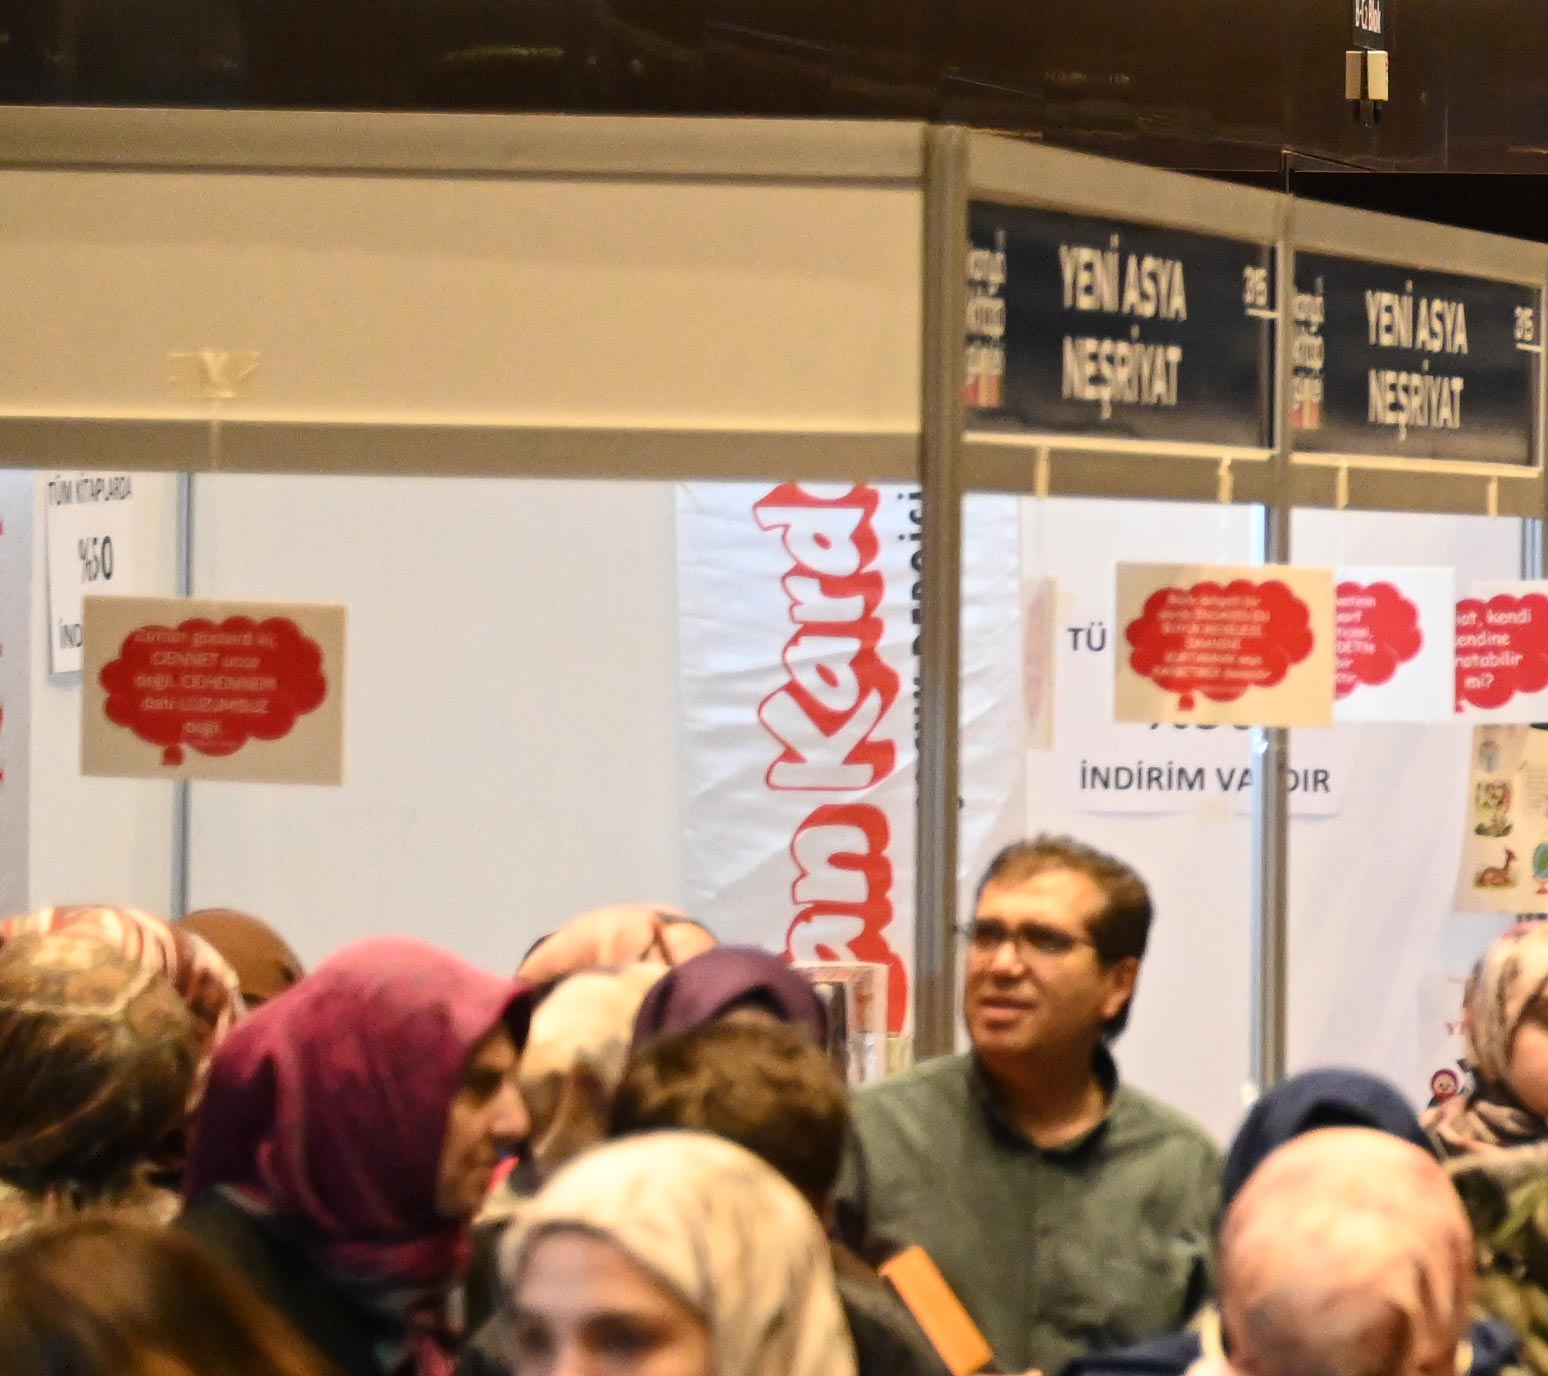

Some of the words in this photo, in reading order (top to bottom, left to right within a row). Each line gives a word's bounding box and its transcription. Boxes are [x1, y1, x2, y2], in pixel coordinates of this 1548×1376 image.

[1059, 233, 1120, 312] YENİ
[1122, 253, 1187, 321] ASYA
[1365, 279, 1413, 348] YENİ
[1415, 298, 1468, 354] ASYA
[1062, 324, 1183, 420] NEŞRİYAT
[1367, 358, 1464, 441] NEŞRİYAT
[752, 482, 902, 792] Kard
[1080, 760, 1205, 791] İNDİRİM
